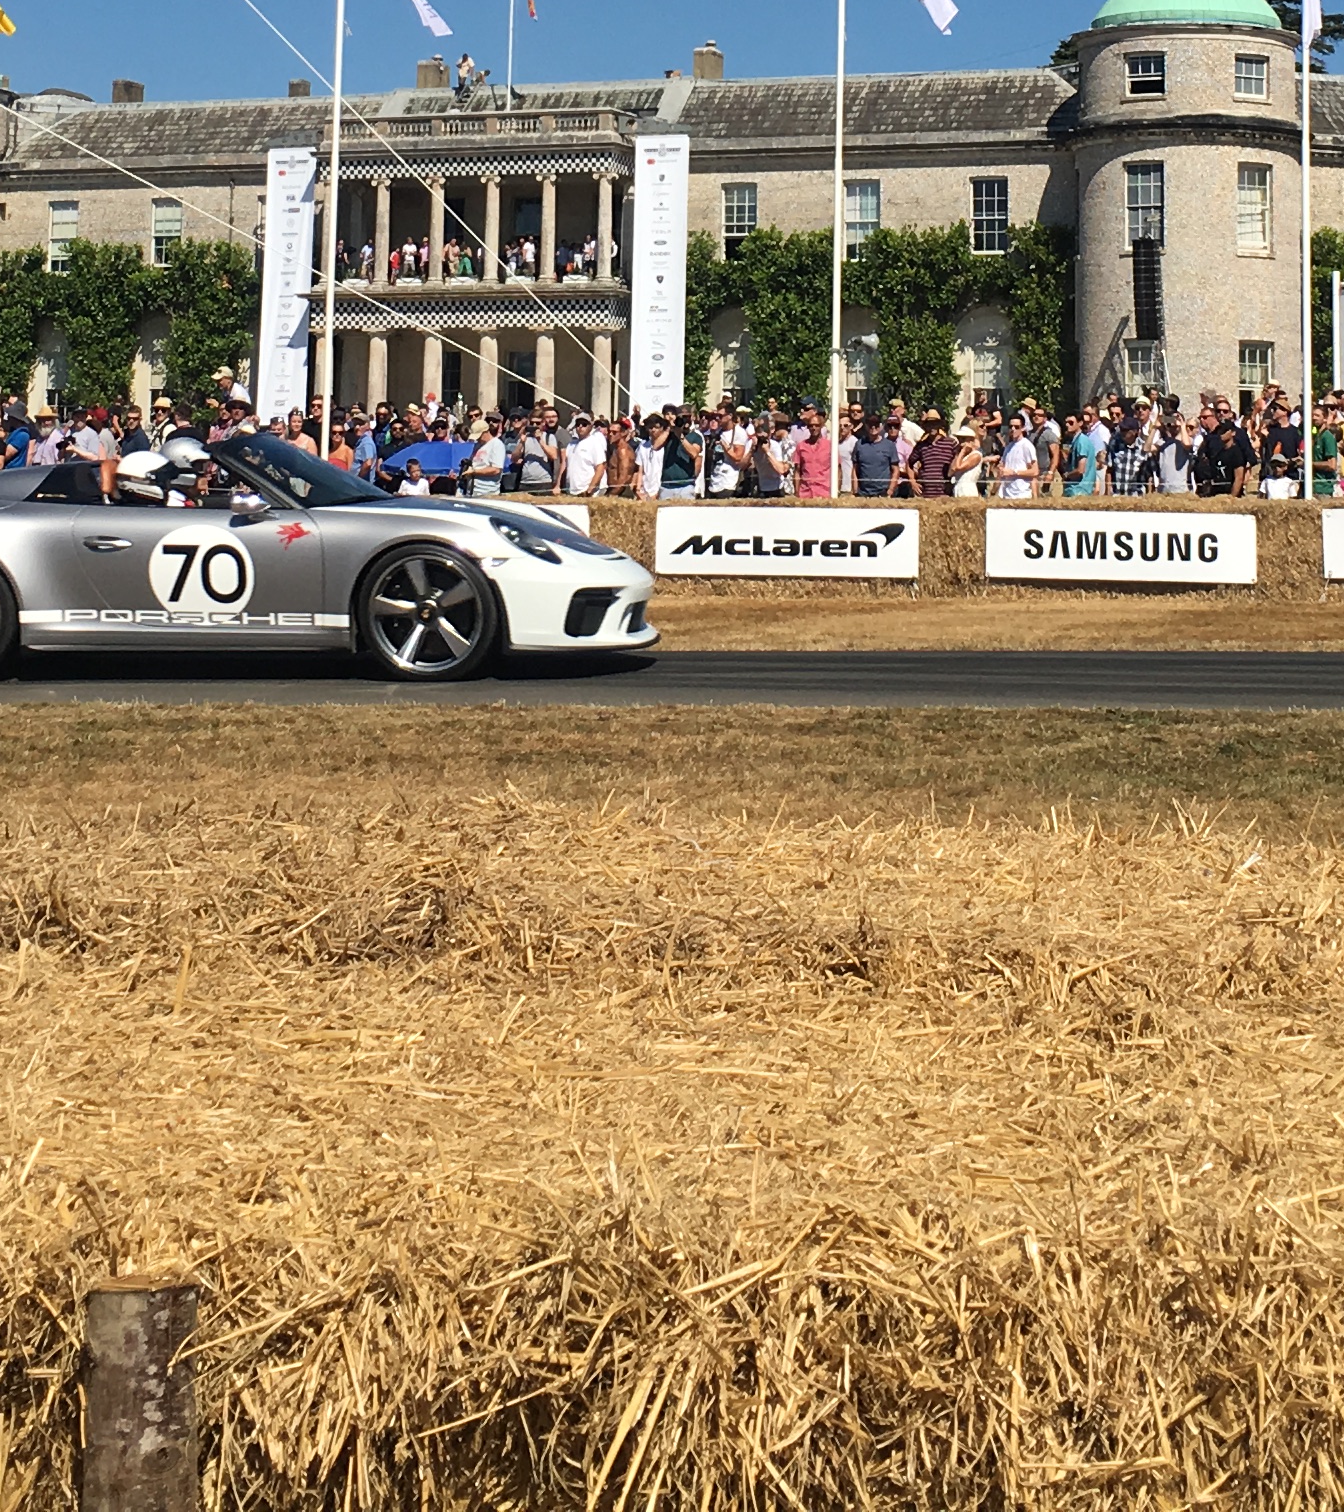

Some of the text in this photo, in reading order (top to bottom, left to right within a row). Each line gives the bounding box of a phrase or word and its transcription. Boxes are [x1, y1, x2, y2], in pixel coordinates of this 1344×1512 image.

[669, 534, 878, 558] McLaren
[1022, 528, 1219, 563] SAMSUNG
[161, 543, 248, 604] 70
[64, 609, 314, 626] PORSCHE
